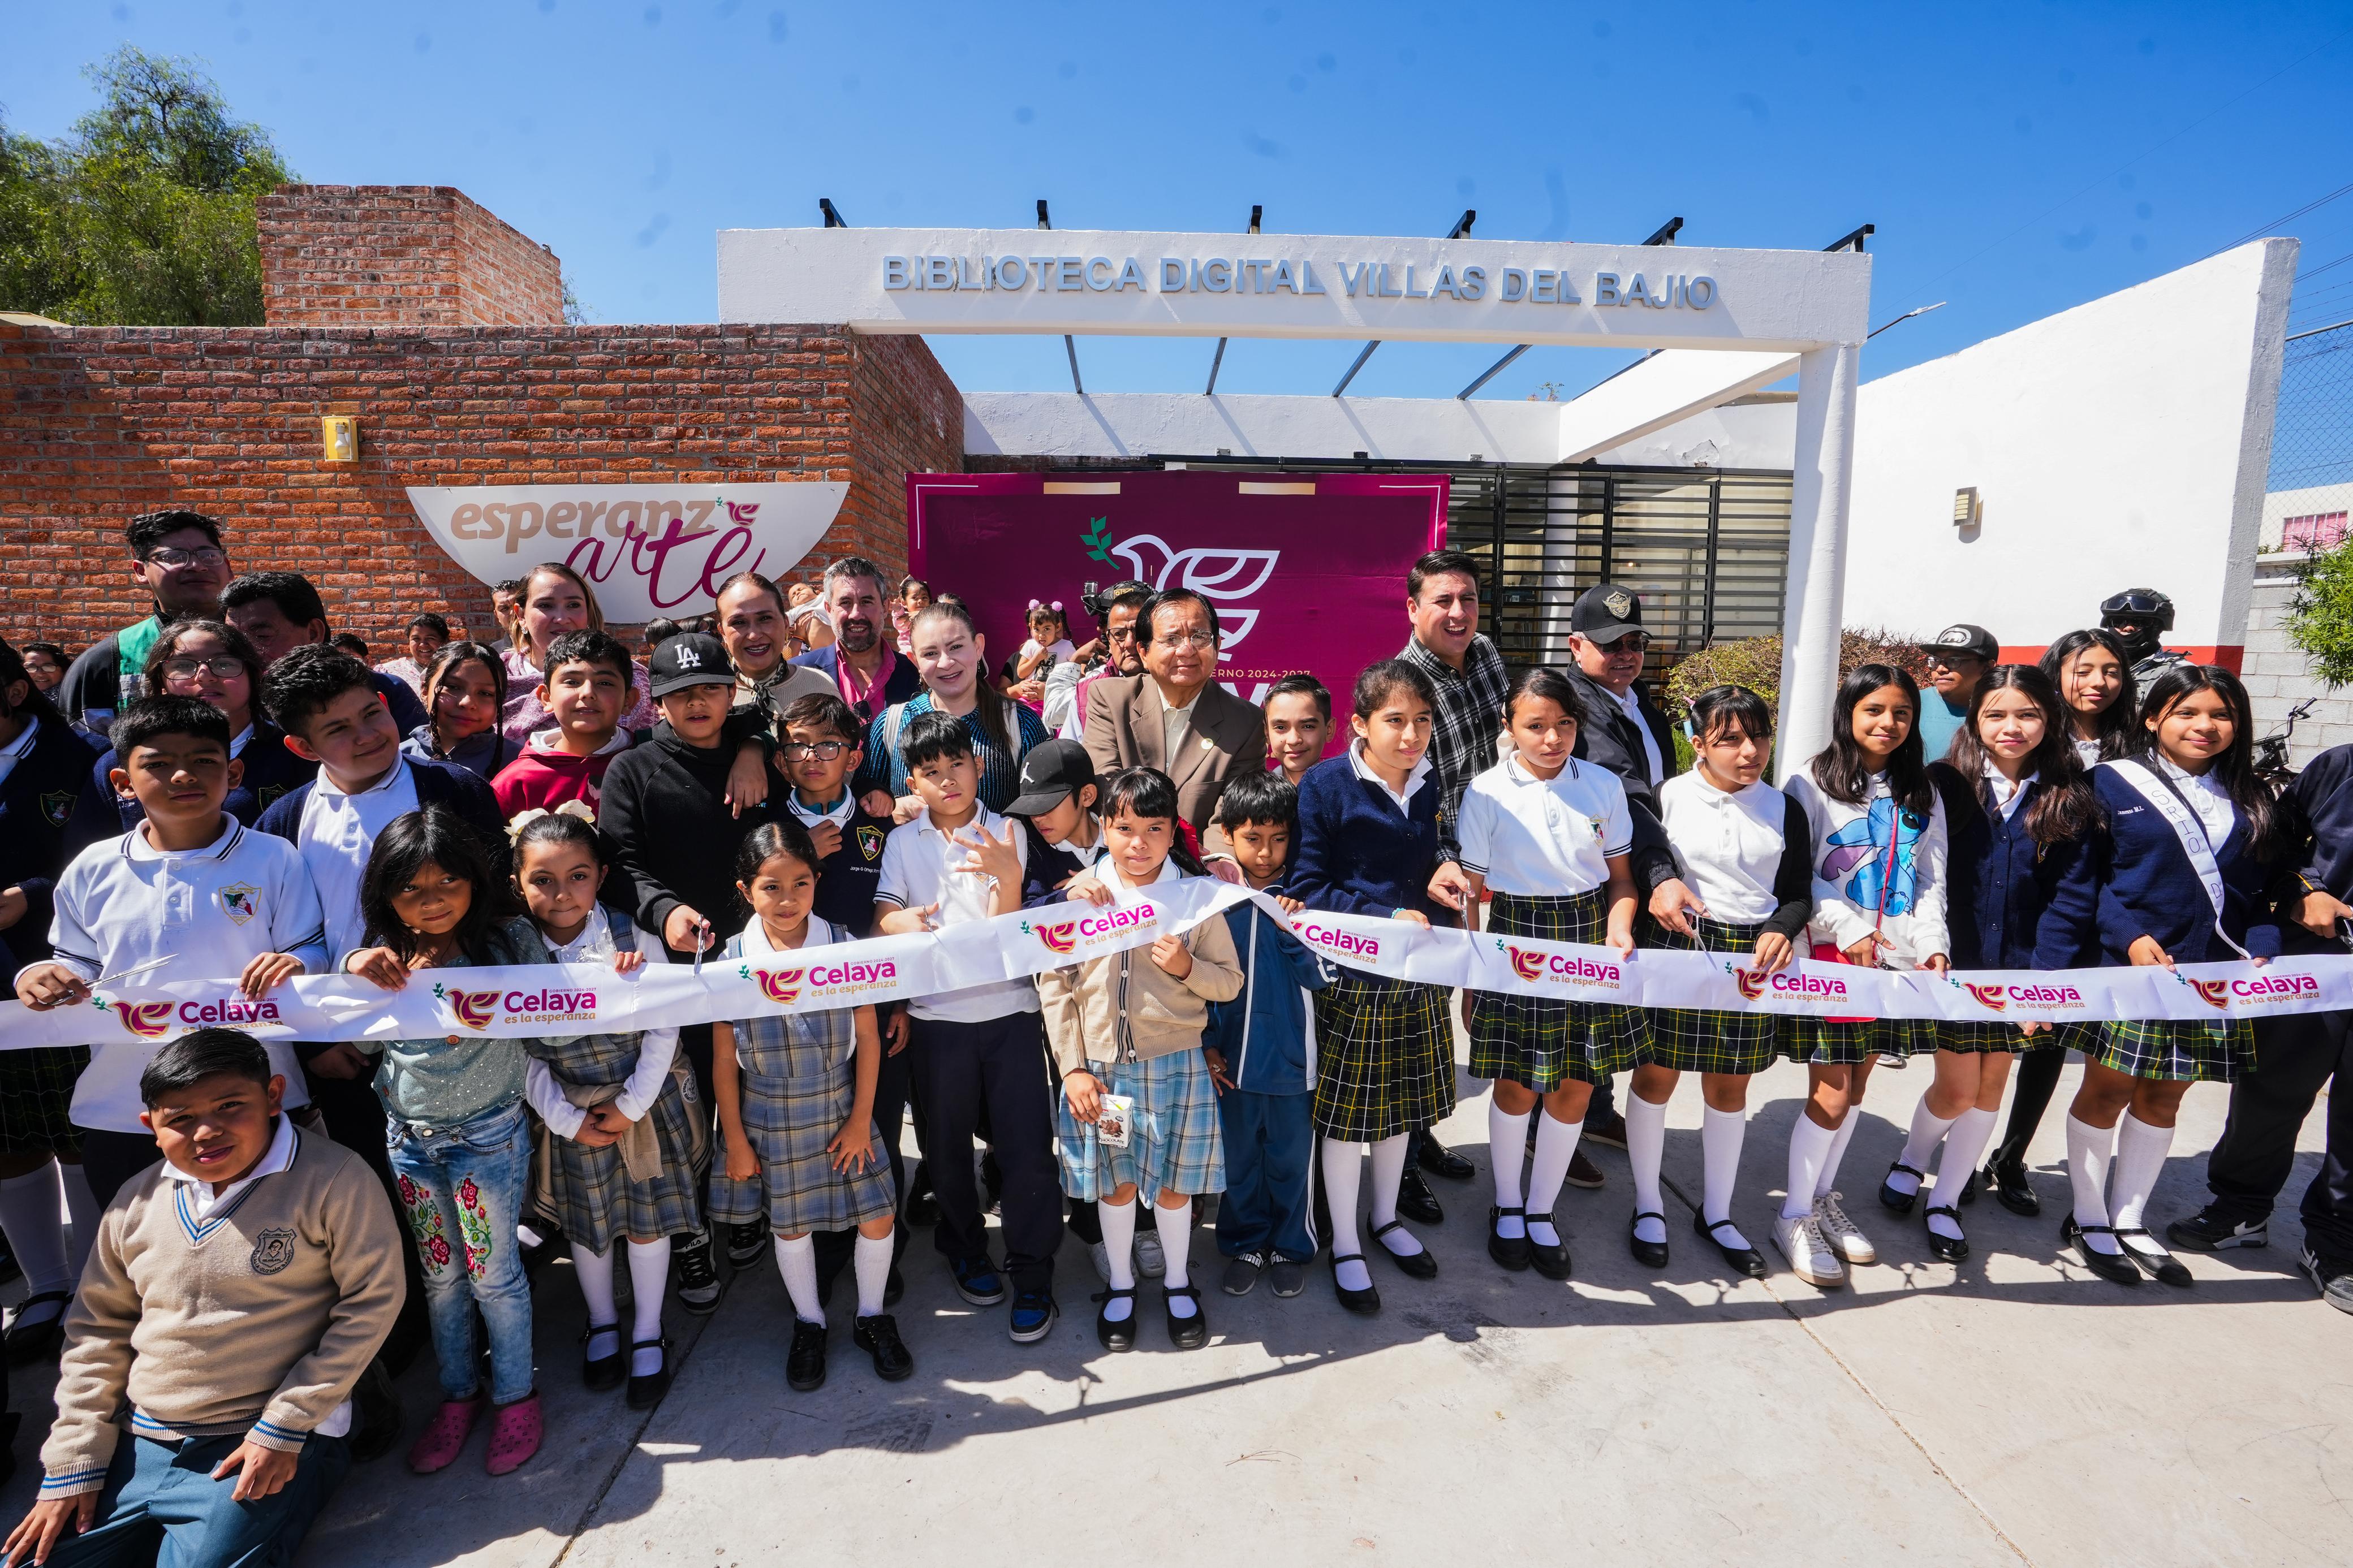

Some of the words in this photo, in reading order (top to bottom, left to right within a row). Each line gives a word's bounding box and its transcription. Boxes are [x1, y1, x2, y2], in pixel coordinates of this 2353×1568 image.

[882, 255, 1147, 292] BIBLIOTECA
[1160, 258, 1325, 295] DIGITAL
[1337, 261, 1486, 301] VILLAS
[1499, 267, 1581, 304] DEL
[1594, 272, 1718, 310] BAJIO
[566, 518, 766, 608] arte
[675, 644, 701, 669] LA
[1080, 905, 1155, 936] Celaya
[1097, 934, 1107, 943] la
[1109, 919, 1157, 939] esperanza
[1305, 925, 1379, 956] Celaya
[1328, 947, 1377, 964] esperanza
[809, 961, 896, 987] Celaya
[1549, 956, 1620, 981] Celaya
[826, 986, 836, 995] la
[839, 979, 897, 995] esperanza
[1572, 977, 1619, 990] esperanza
[1772, 973, 1846, 996] Celaya
[2008, 985, 2081, 1003] Celaya
[2231, 977, 2318, 997] Celaya
[504, 989, 596, 1014] Celaya
[1796, 993, 1847, 1003] esperanza
[2037, 1002, 2085, 1011] esperanza
[2253, 995, 2265, 1004] la
[2267, 991, 2320, 1004] esperanza
[179, 999, 279, 1023] Celaya
[520, 1013, 532, 1023] la
[535, 1012, 596, 1025] esperanza
[686, 1239, 701, 1249] FILA
[1234, 1253, 1261, 1268] PUMA
